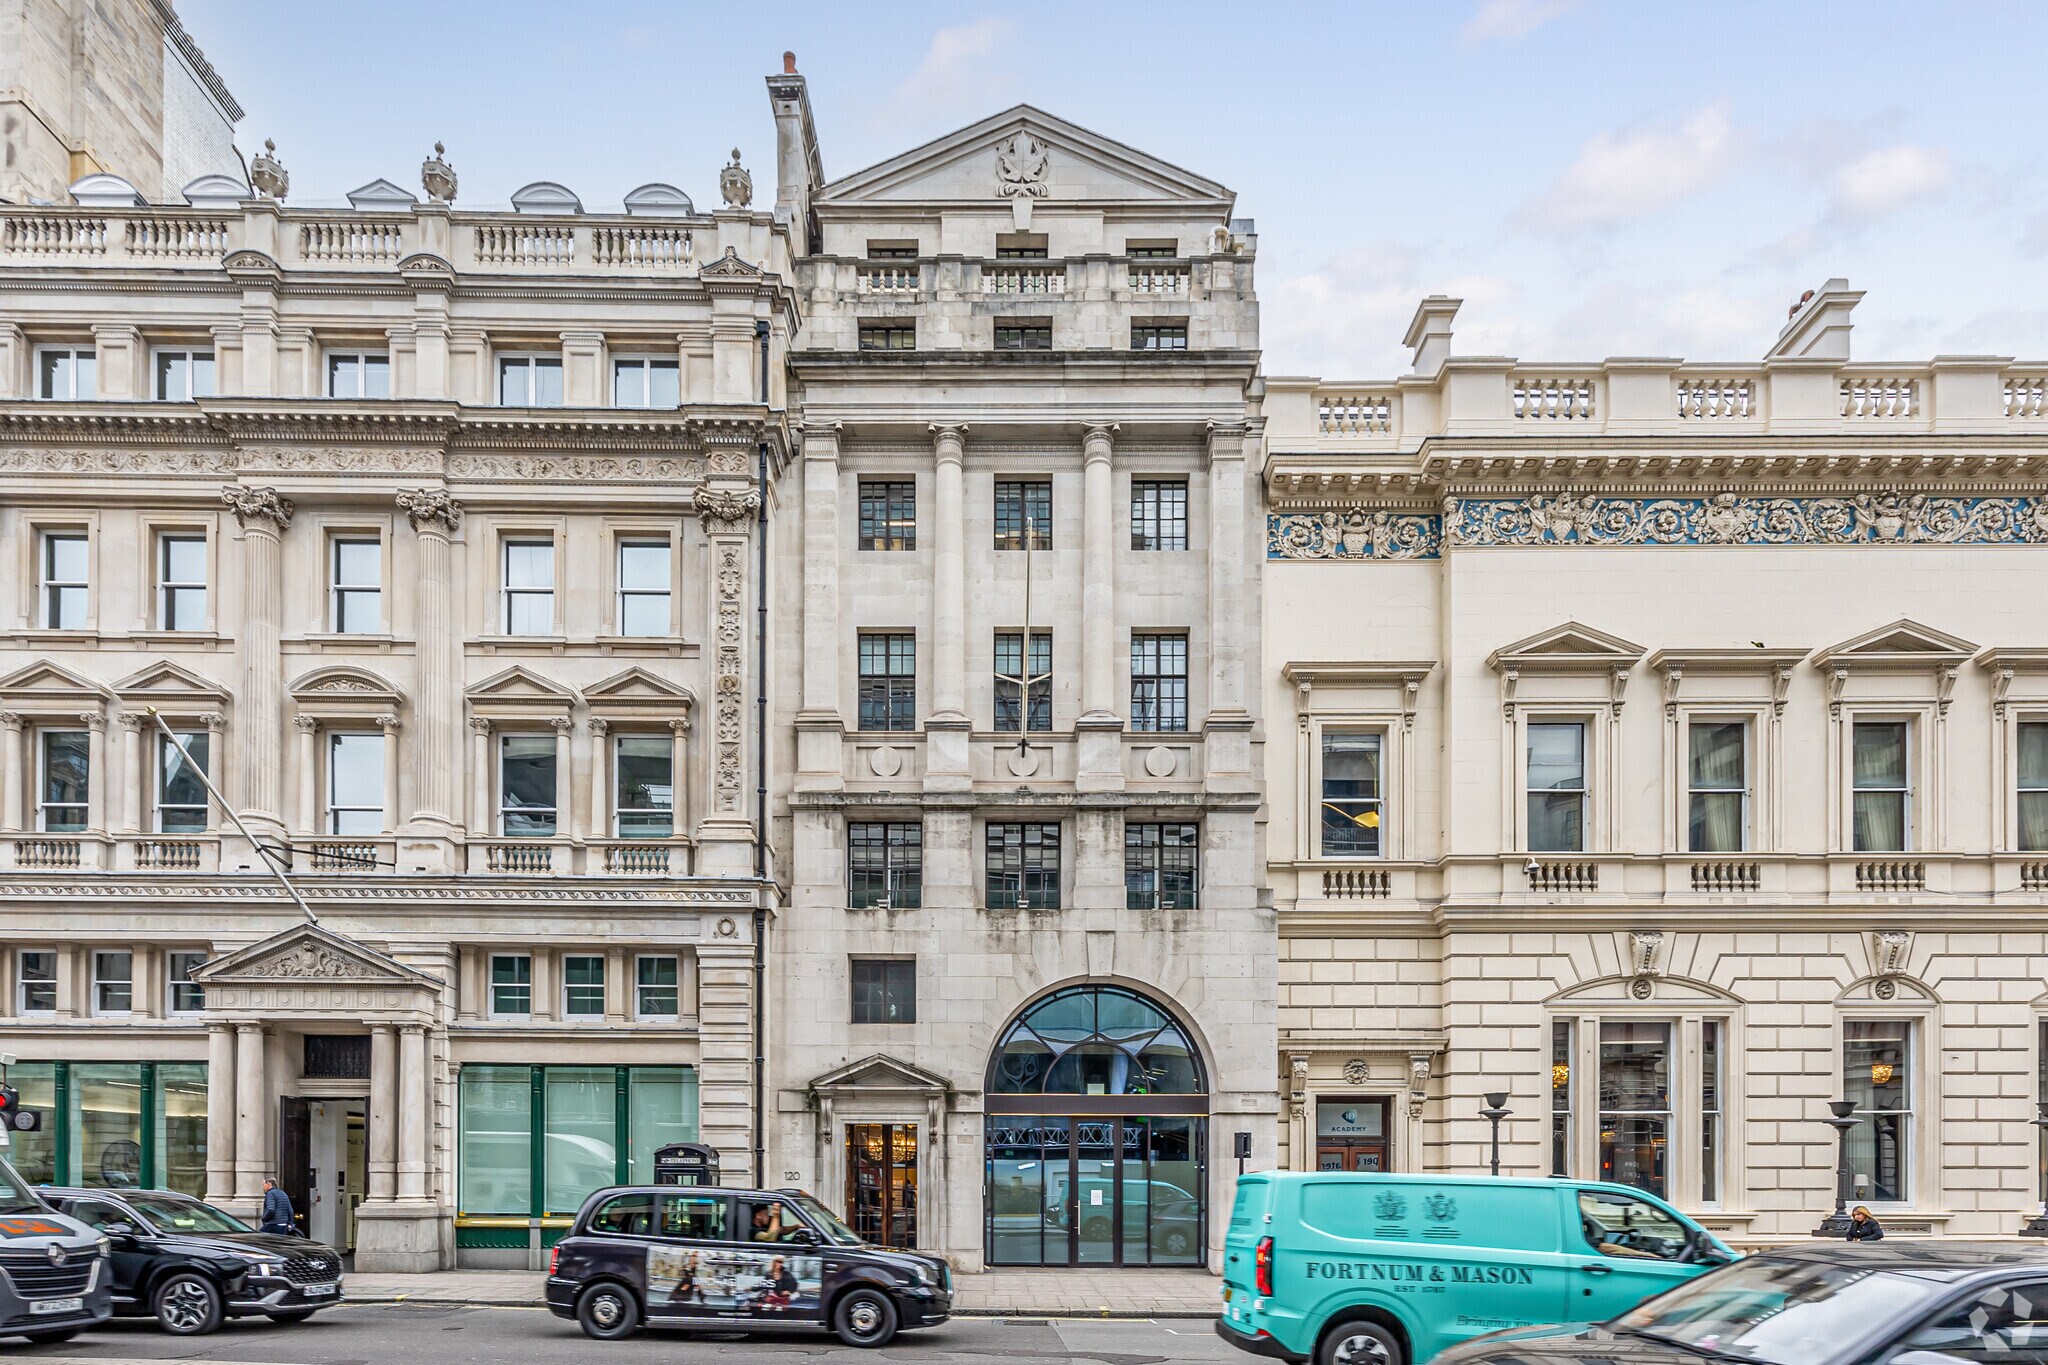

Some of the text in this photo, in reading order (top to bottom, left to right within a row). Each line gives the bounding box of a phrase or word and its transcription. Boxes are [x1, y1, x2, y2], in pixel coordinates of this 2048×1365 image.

[784, 1171, 801, 1181] 120
[1305, 1262, 1534, 1285] FORTNUM & MASON
